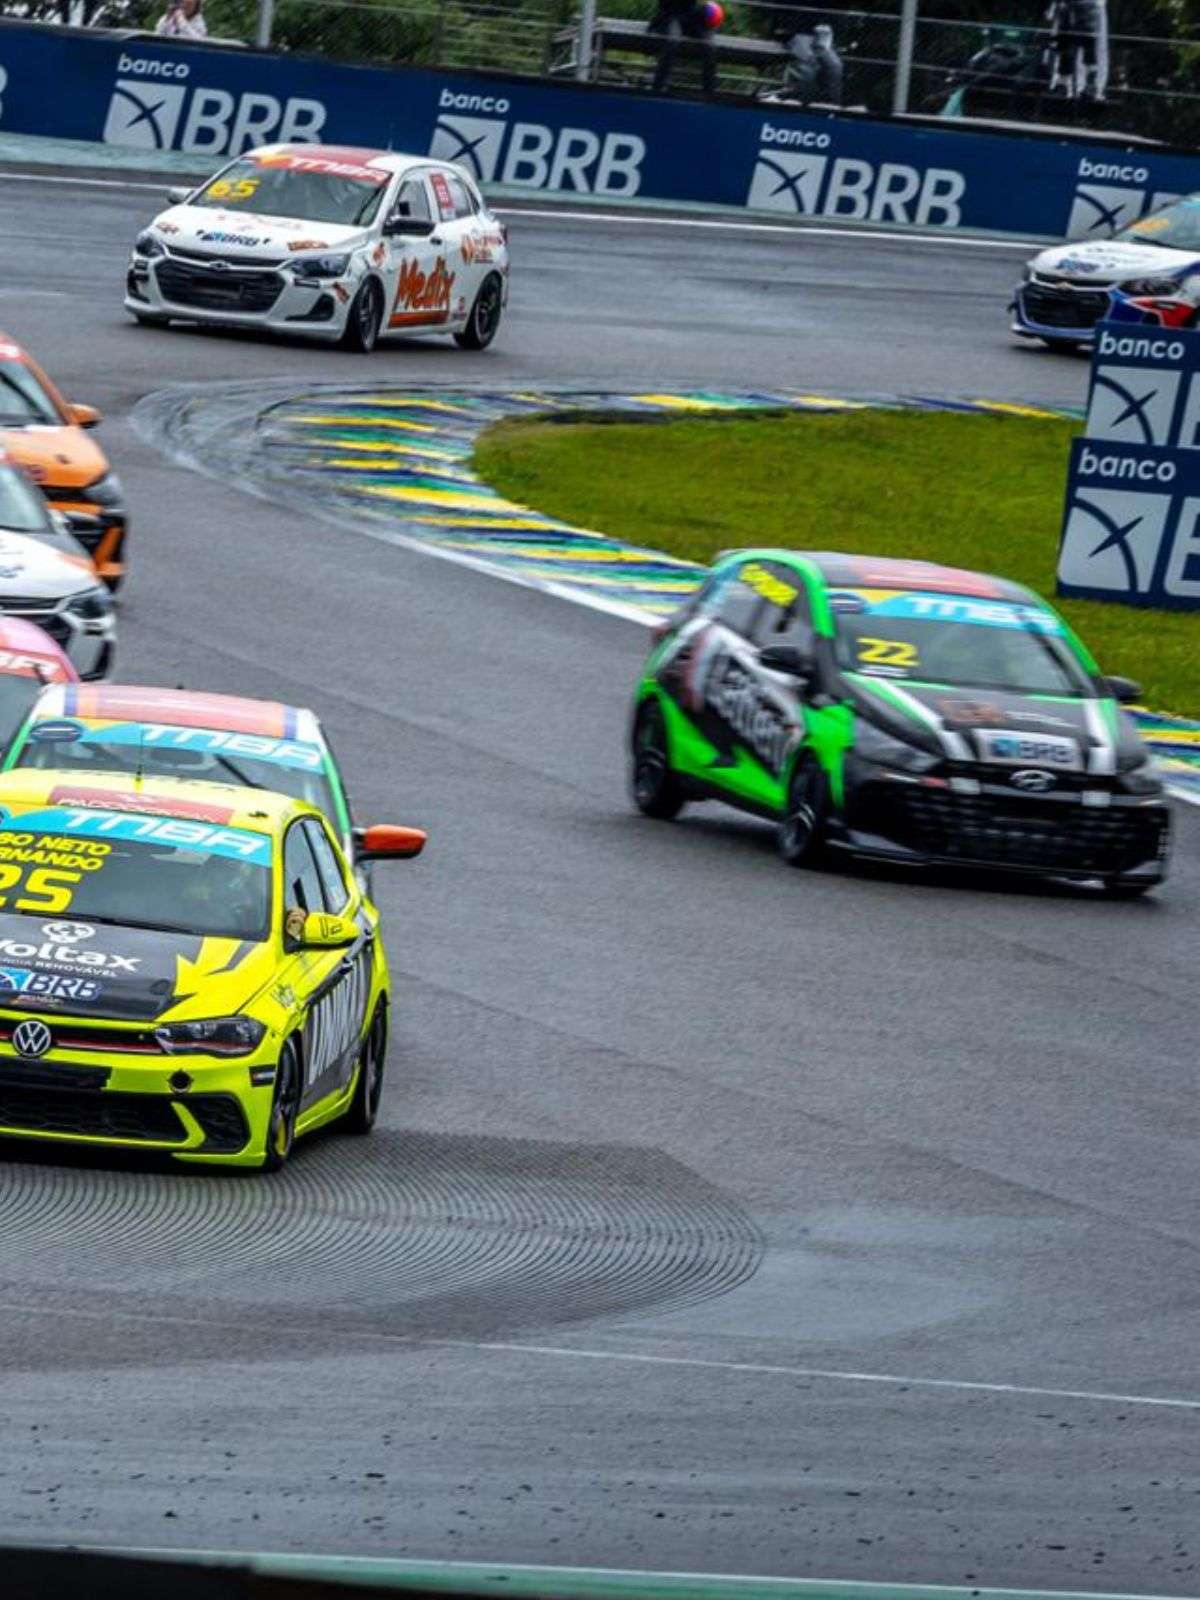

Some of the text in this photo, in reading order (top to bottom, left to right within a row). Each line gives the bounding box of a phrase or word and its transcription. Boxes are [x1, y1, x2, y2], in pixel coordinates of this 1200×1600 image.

[117, 53, 189, 79] banco
[439, 88, 510, 113] banco
[182, 87, 327, 157] BRB
[760, 123, 831, 149] banco
[503, 122, 647, 197] BRB
[1079, 158, 1149, 183] banco
[825, 157, 966, 227] BRB
[1099, 331, 1185, 360] banco
[1078, 447, 1176, 482] banco
[856, 638, 920, 667] 22
[36, 837, 113, 856] NETO
[27, 972, 99, 999] BRB
